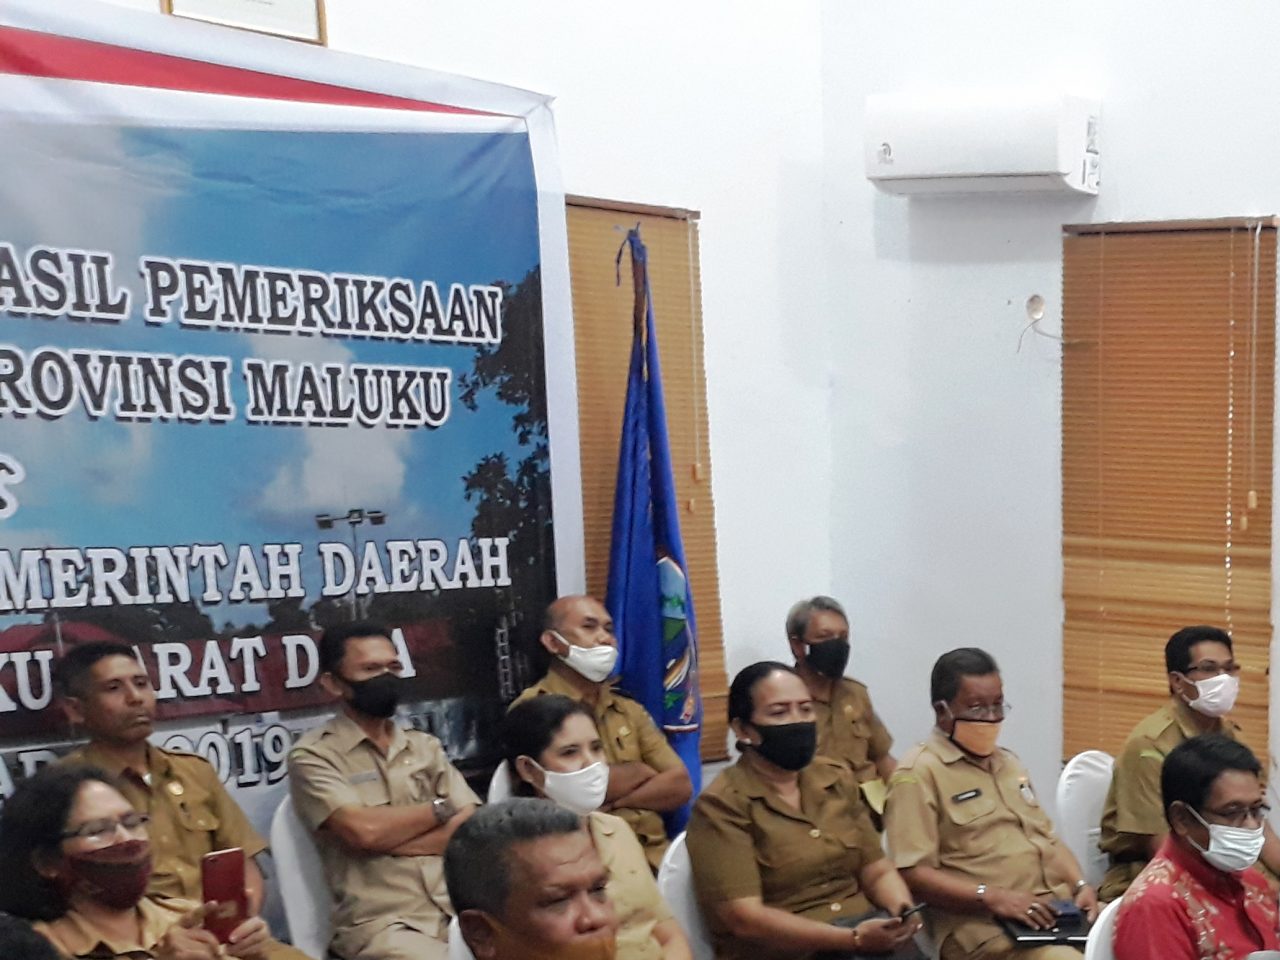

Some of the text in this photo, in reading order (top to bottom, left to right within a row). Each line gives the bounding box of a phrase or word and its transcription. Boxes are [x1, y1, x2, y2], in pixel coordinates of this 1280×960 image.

[143, 258, 501, 340] PEMERIKSAAN
[0, 347, 450, 424] ROVINSI MALUKU
[0, 537, 512, 611] MERINTAH DAERAH
